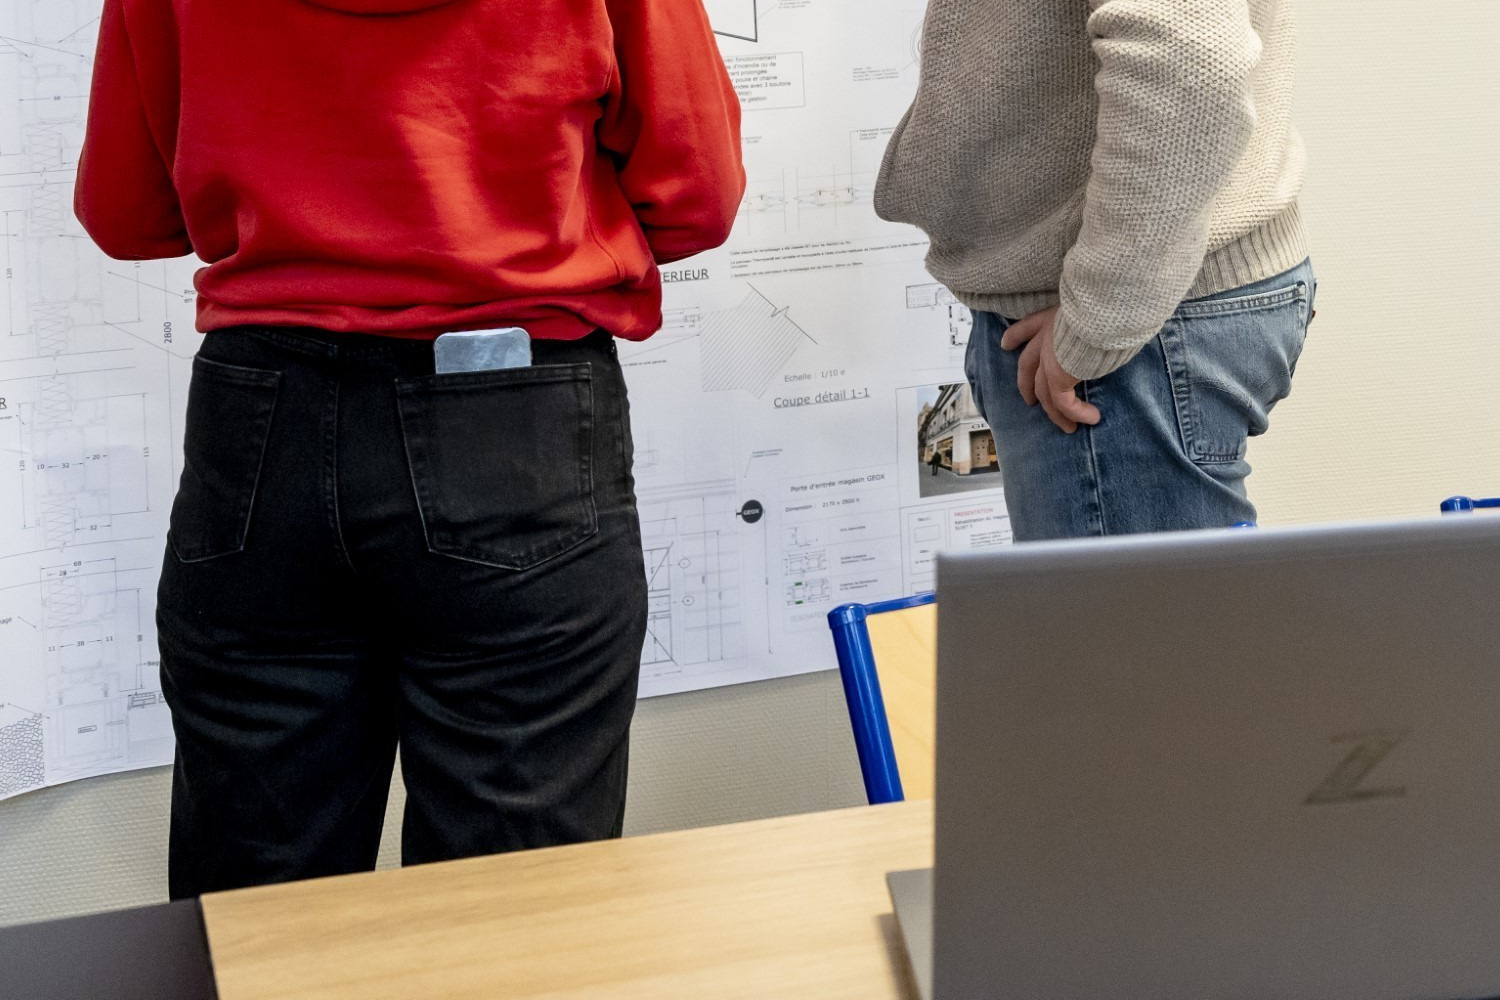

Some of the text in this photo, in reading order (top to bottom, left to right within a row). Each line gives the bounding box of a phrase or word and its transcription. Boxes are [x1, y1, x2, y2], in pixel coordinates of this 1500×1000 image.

[660, 268, 709, 282] ERIEUR
[784, 372, 812, 382] Echelle
[821, 369, 839, 378] 1/10
[773, 387, 871, 408] Coupe détail 1-1
[790, 474, 885, 493] Porte d'entrée magasin GEOX
[785, 504, 812, 512] Dimension
